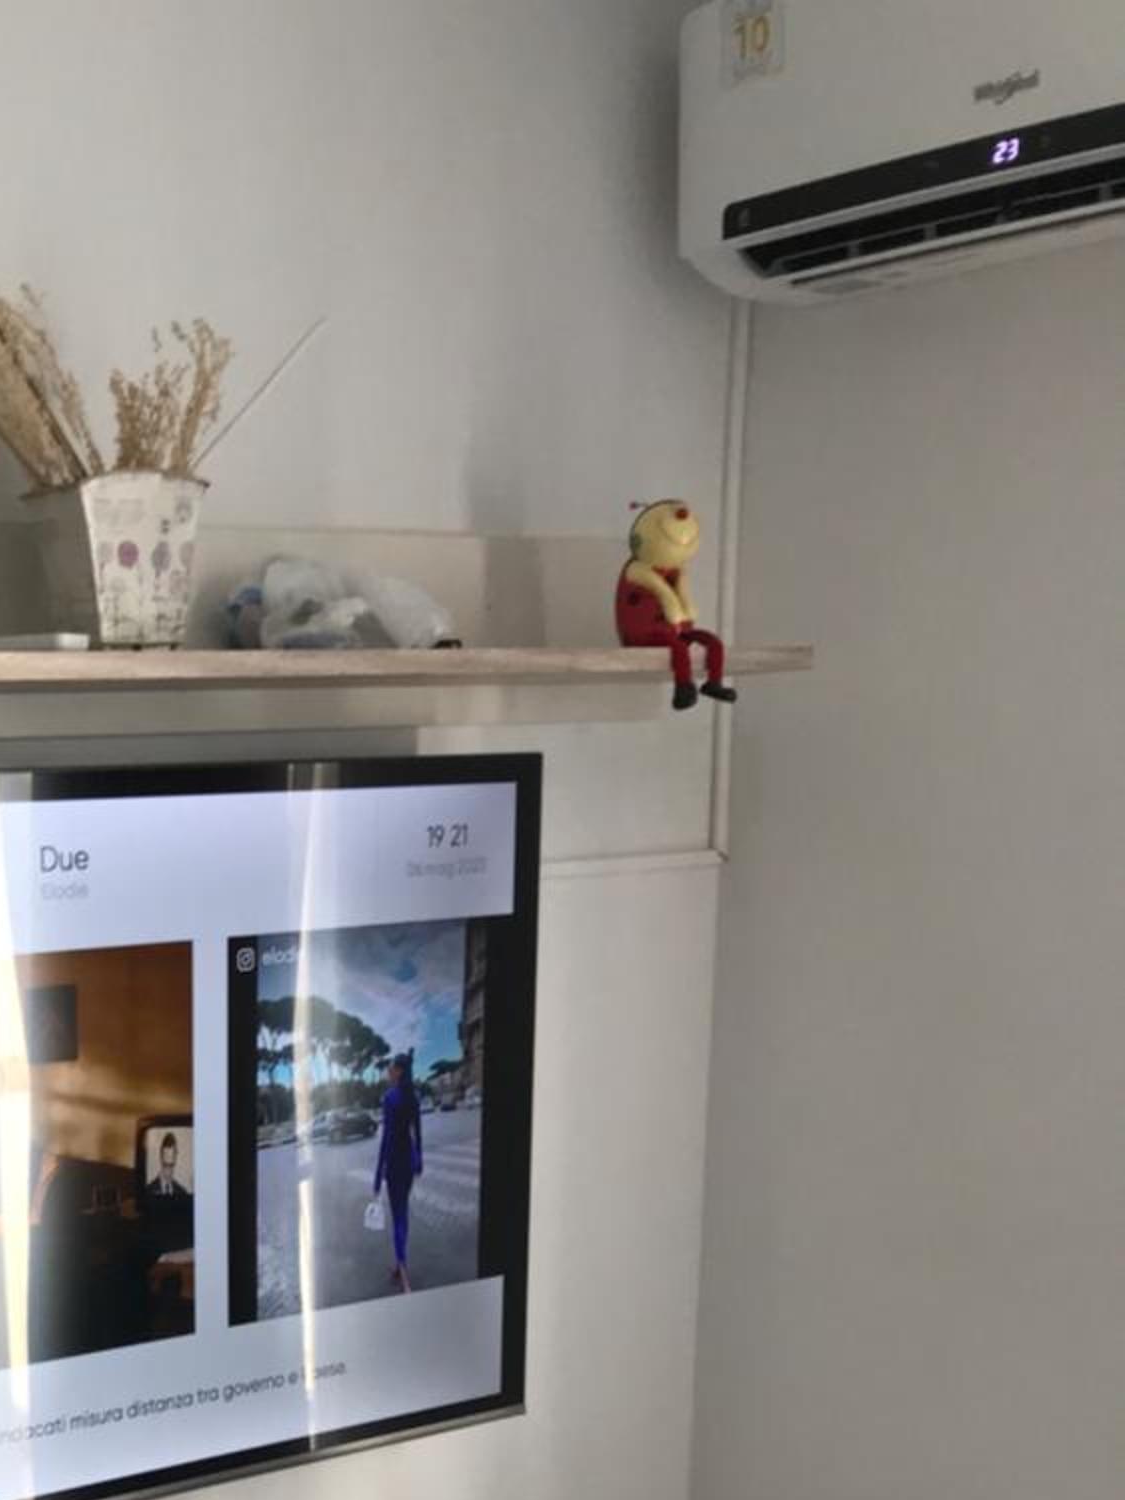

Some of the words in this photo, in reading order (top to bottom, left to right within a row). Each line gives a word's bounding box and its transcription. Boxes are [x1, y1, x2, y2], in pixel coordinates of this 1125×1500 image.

[733, 16, 771, 60] 10
[991, 137, 1021, 165] 23
[39, 845, 90, 873] Due
[69, 1405, 124, 1430] misura
[127, 1391, 194, 1419] distanza
[197, 1386, 219, 1405] tra
[223, 1374, 284, 1403] governo
[288, 1371, 299, 1384] e
[300, 1361, 347, 1383] aese
